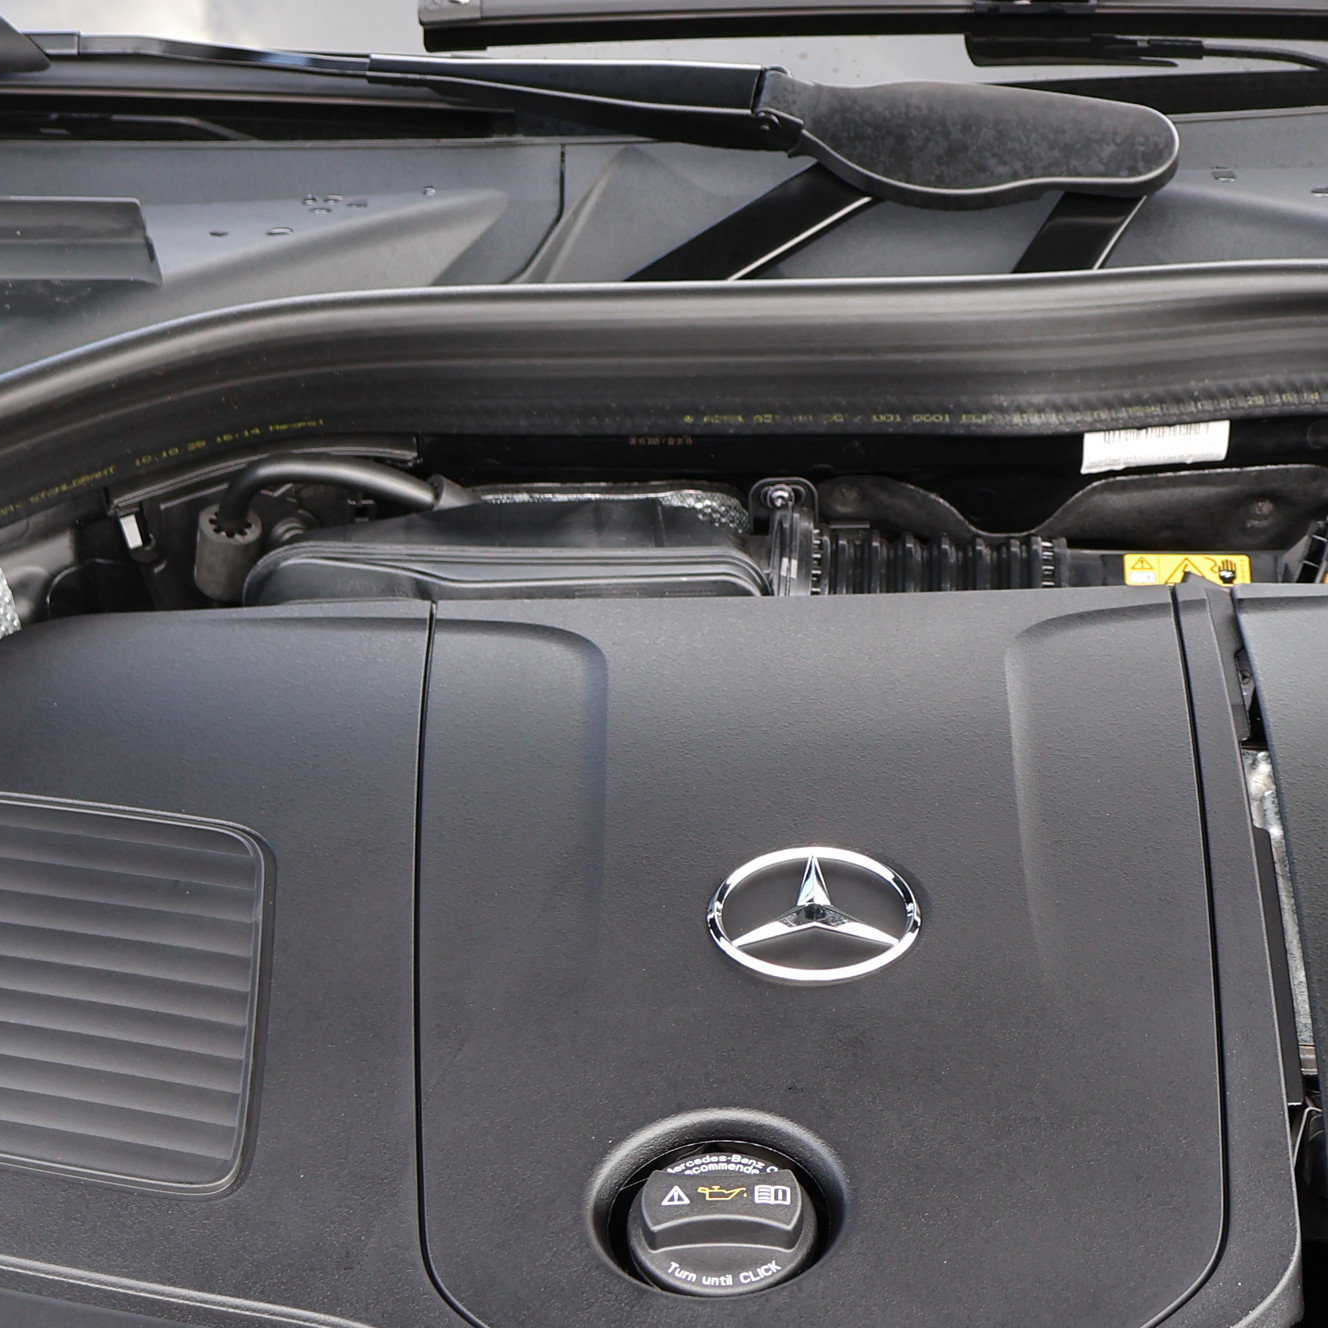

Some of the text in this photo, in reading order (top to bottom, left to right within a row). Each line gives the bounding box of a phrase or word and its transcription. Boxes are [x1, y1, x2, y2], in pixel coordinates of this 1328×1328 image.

[684, 1162, 760, 1175] ecommende
[667, 1260, 782, 1286] Turn until CLICK
